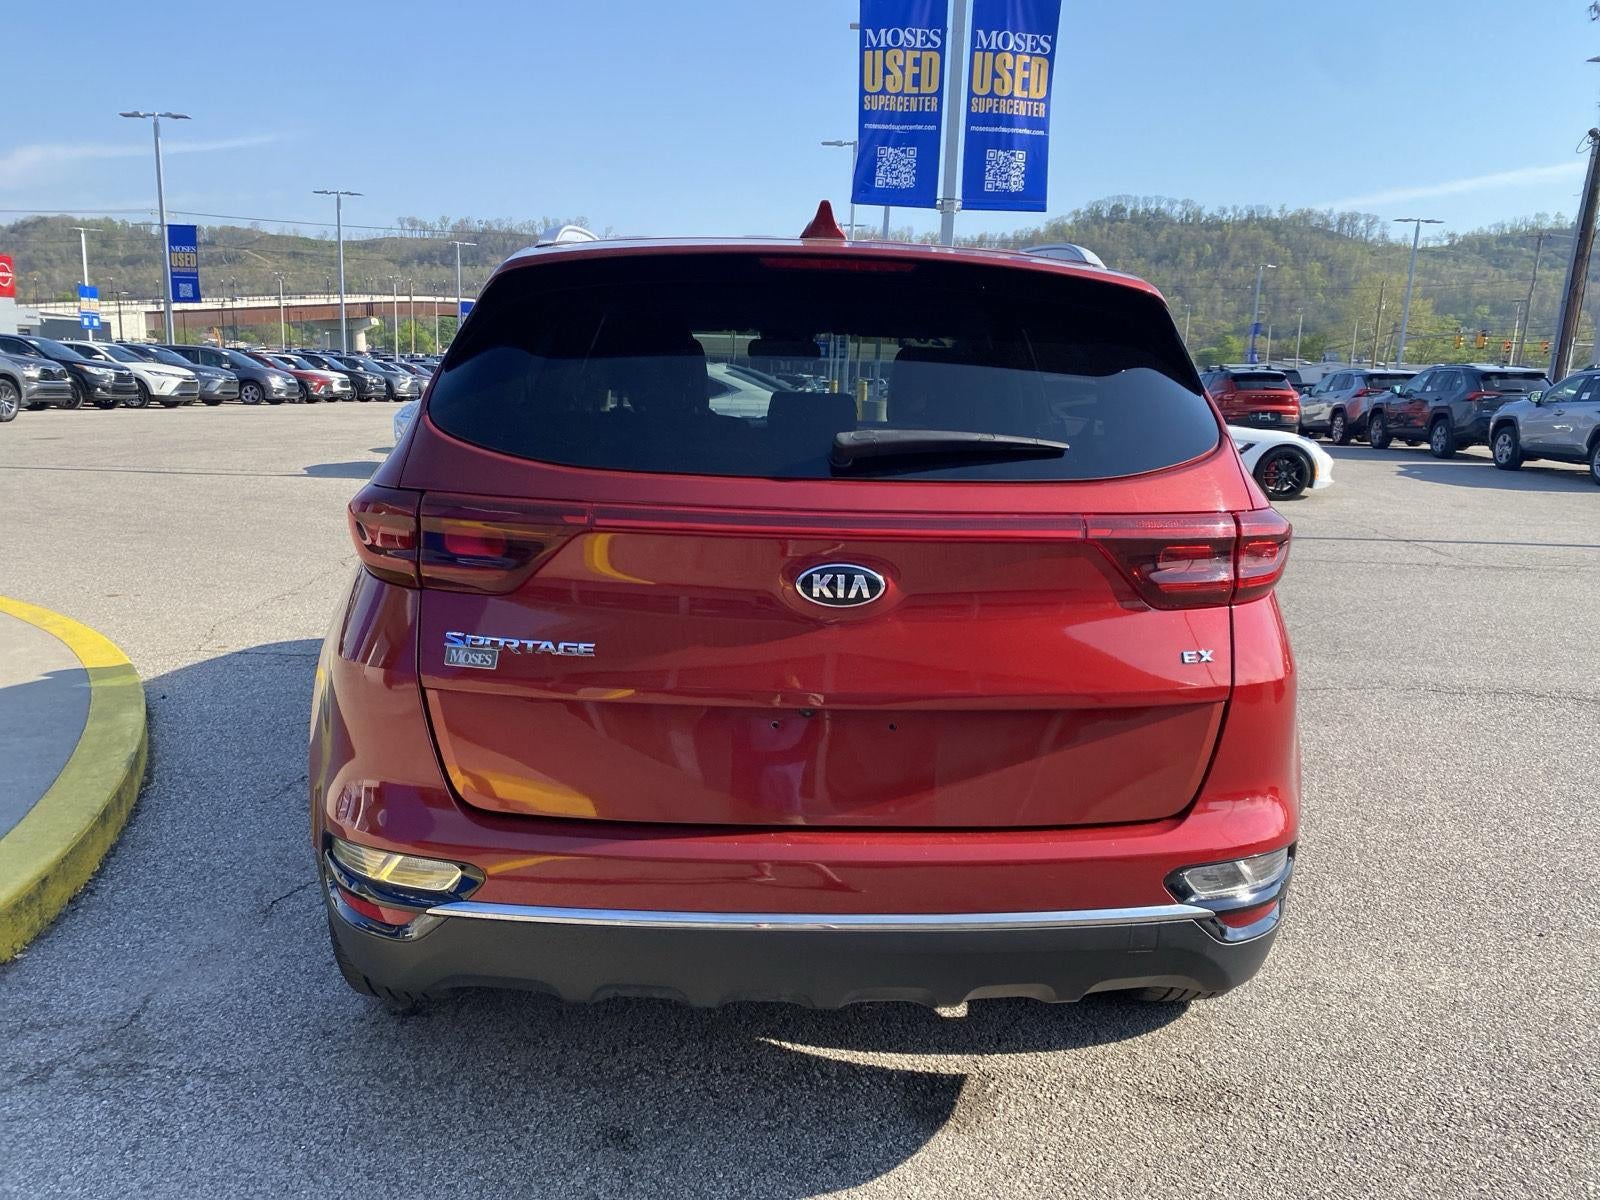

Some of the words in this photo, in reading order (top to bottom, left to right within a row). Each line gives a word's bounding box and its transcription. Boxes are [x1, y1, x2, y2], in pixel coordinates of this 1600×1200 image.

[864, 28, 942, 49] MOSES
[975, 29, 1052, 54] MOSES
[863, 49, 940, 94] USED
[972, 51, 1050, 99] USED
[863, 95, 938, 112] SUPERCENTER
[971, 97, 1046, 118] SUPERCENTER
[171, 252, 197, 267] USED
[812, 573, 871, 599] KIA
[445, 631, 596, 657] SPORTAGE
[449, 649, 492, 666] MOSES
[1181, 648, 1215, 664] EX
